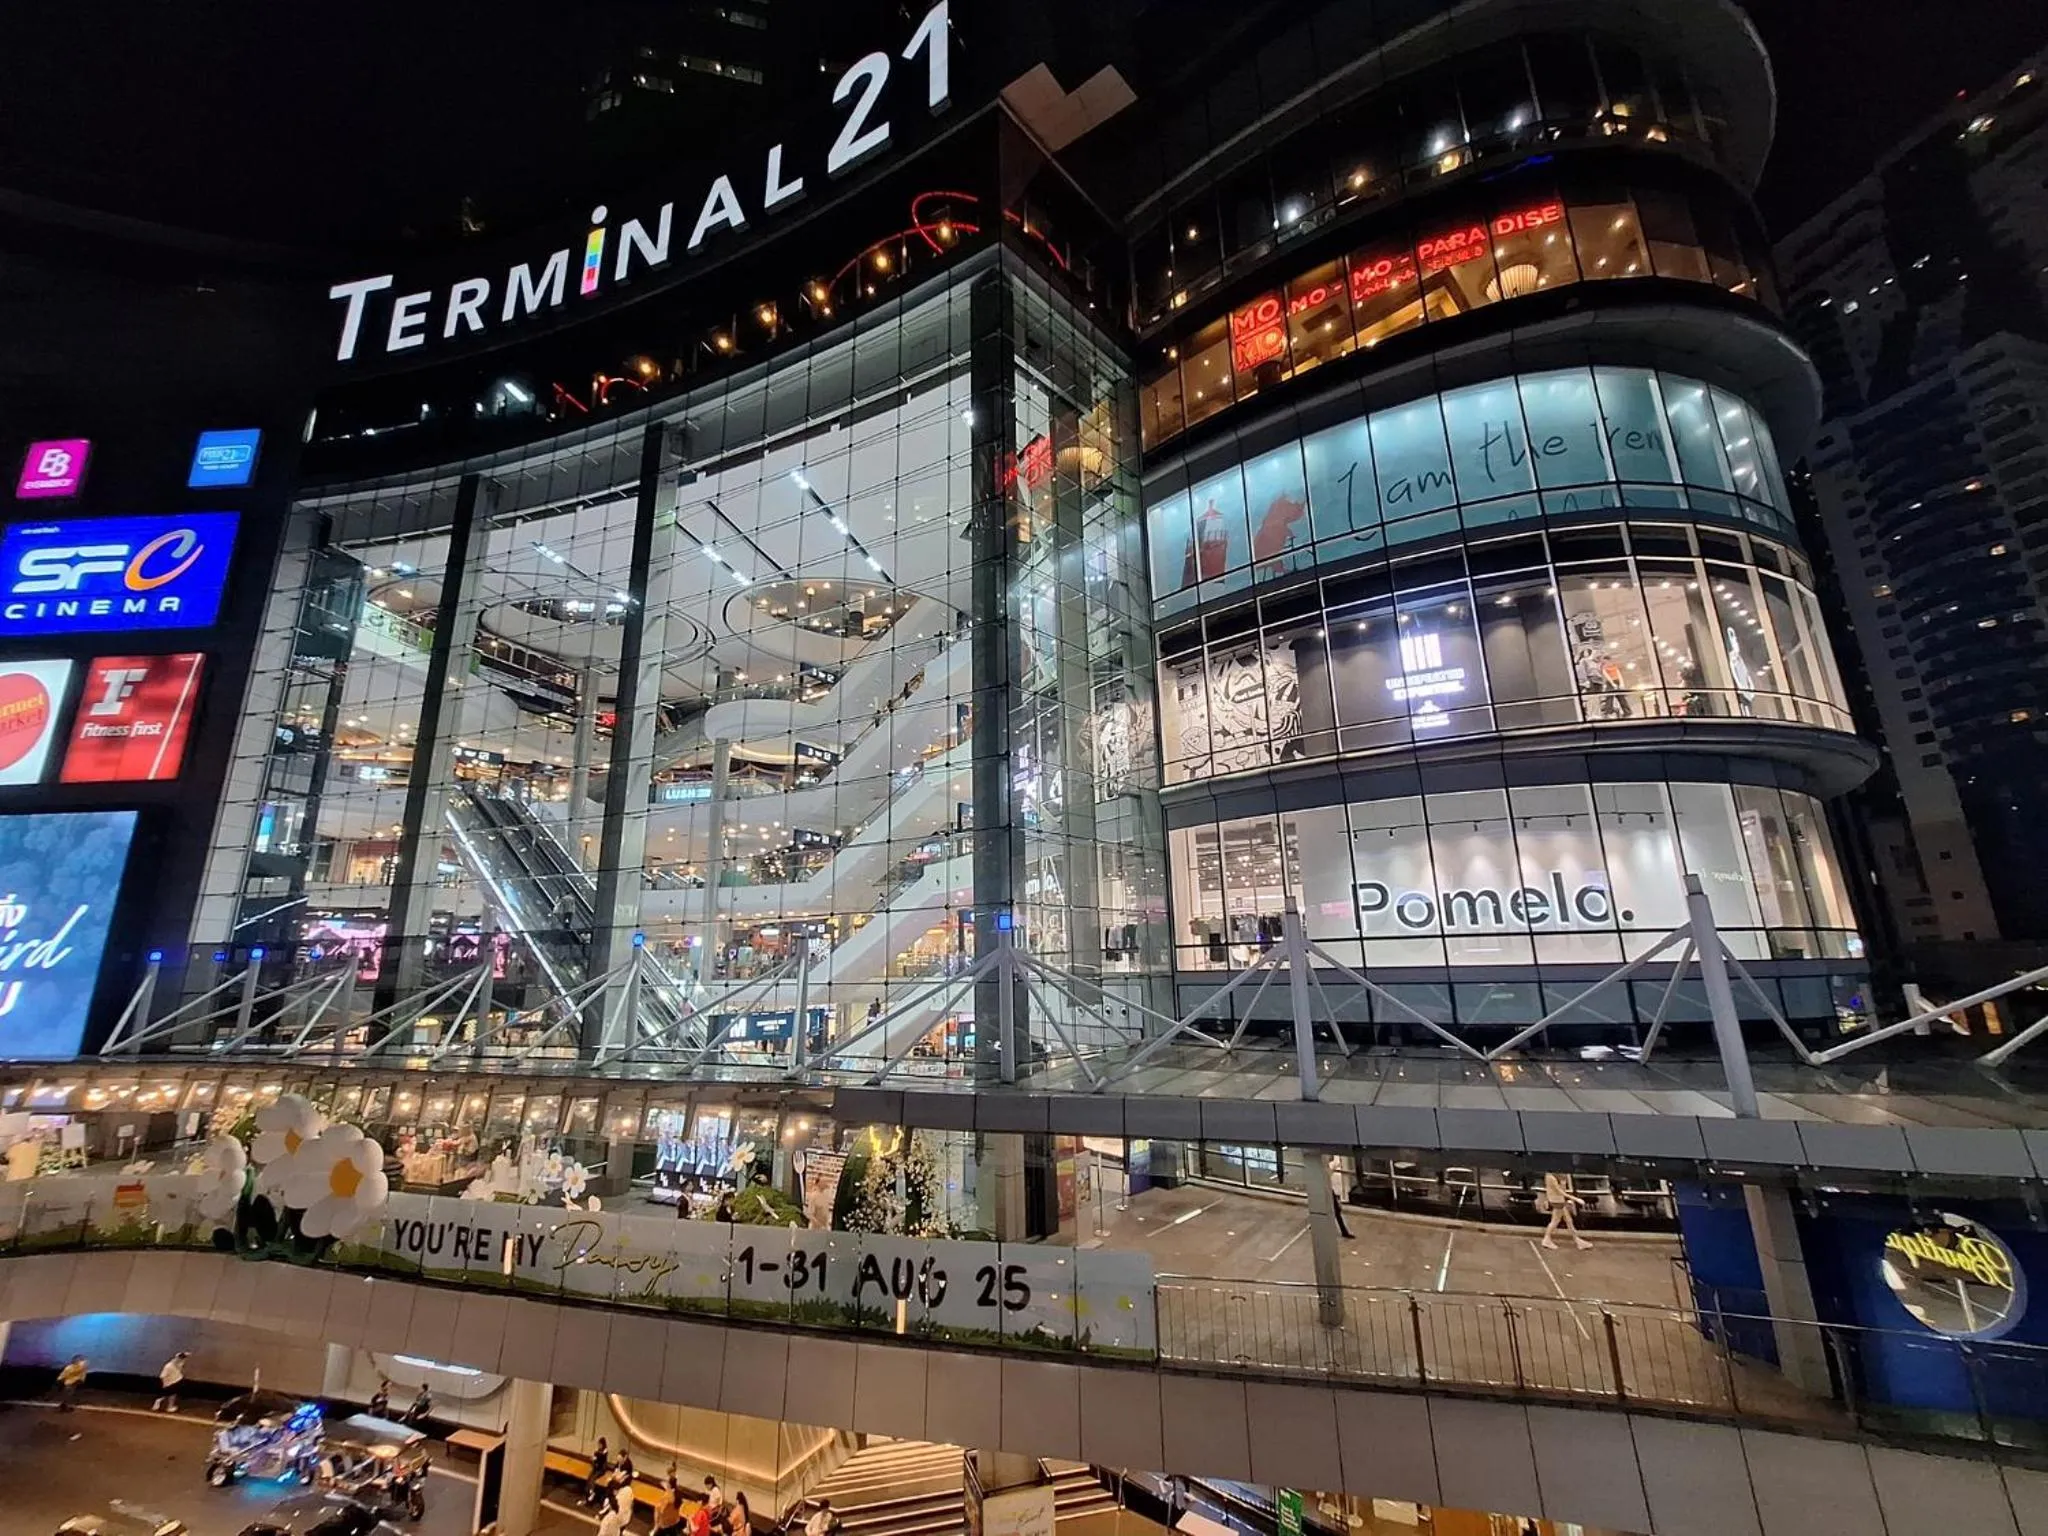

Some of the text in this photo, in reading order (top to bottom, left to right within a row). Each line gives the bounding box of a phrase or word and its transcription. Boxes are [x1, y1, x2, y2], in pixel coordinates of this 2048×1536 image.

[827, 0, 949, 174] 21
[1234, 299, 1279, 334] MO
[1386, 470, 1452, 505] am
[1479, 420, 1568, 482] the
[5, 596, 182, 620] CINEMA
[394, 1218, 492, 1262] YOU'RE
[738, 1246, 827, 1292] 1-31
[852, 1252, 947, 1308] AUG
[975, 1264, 1031, 1312] 25
